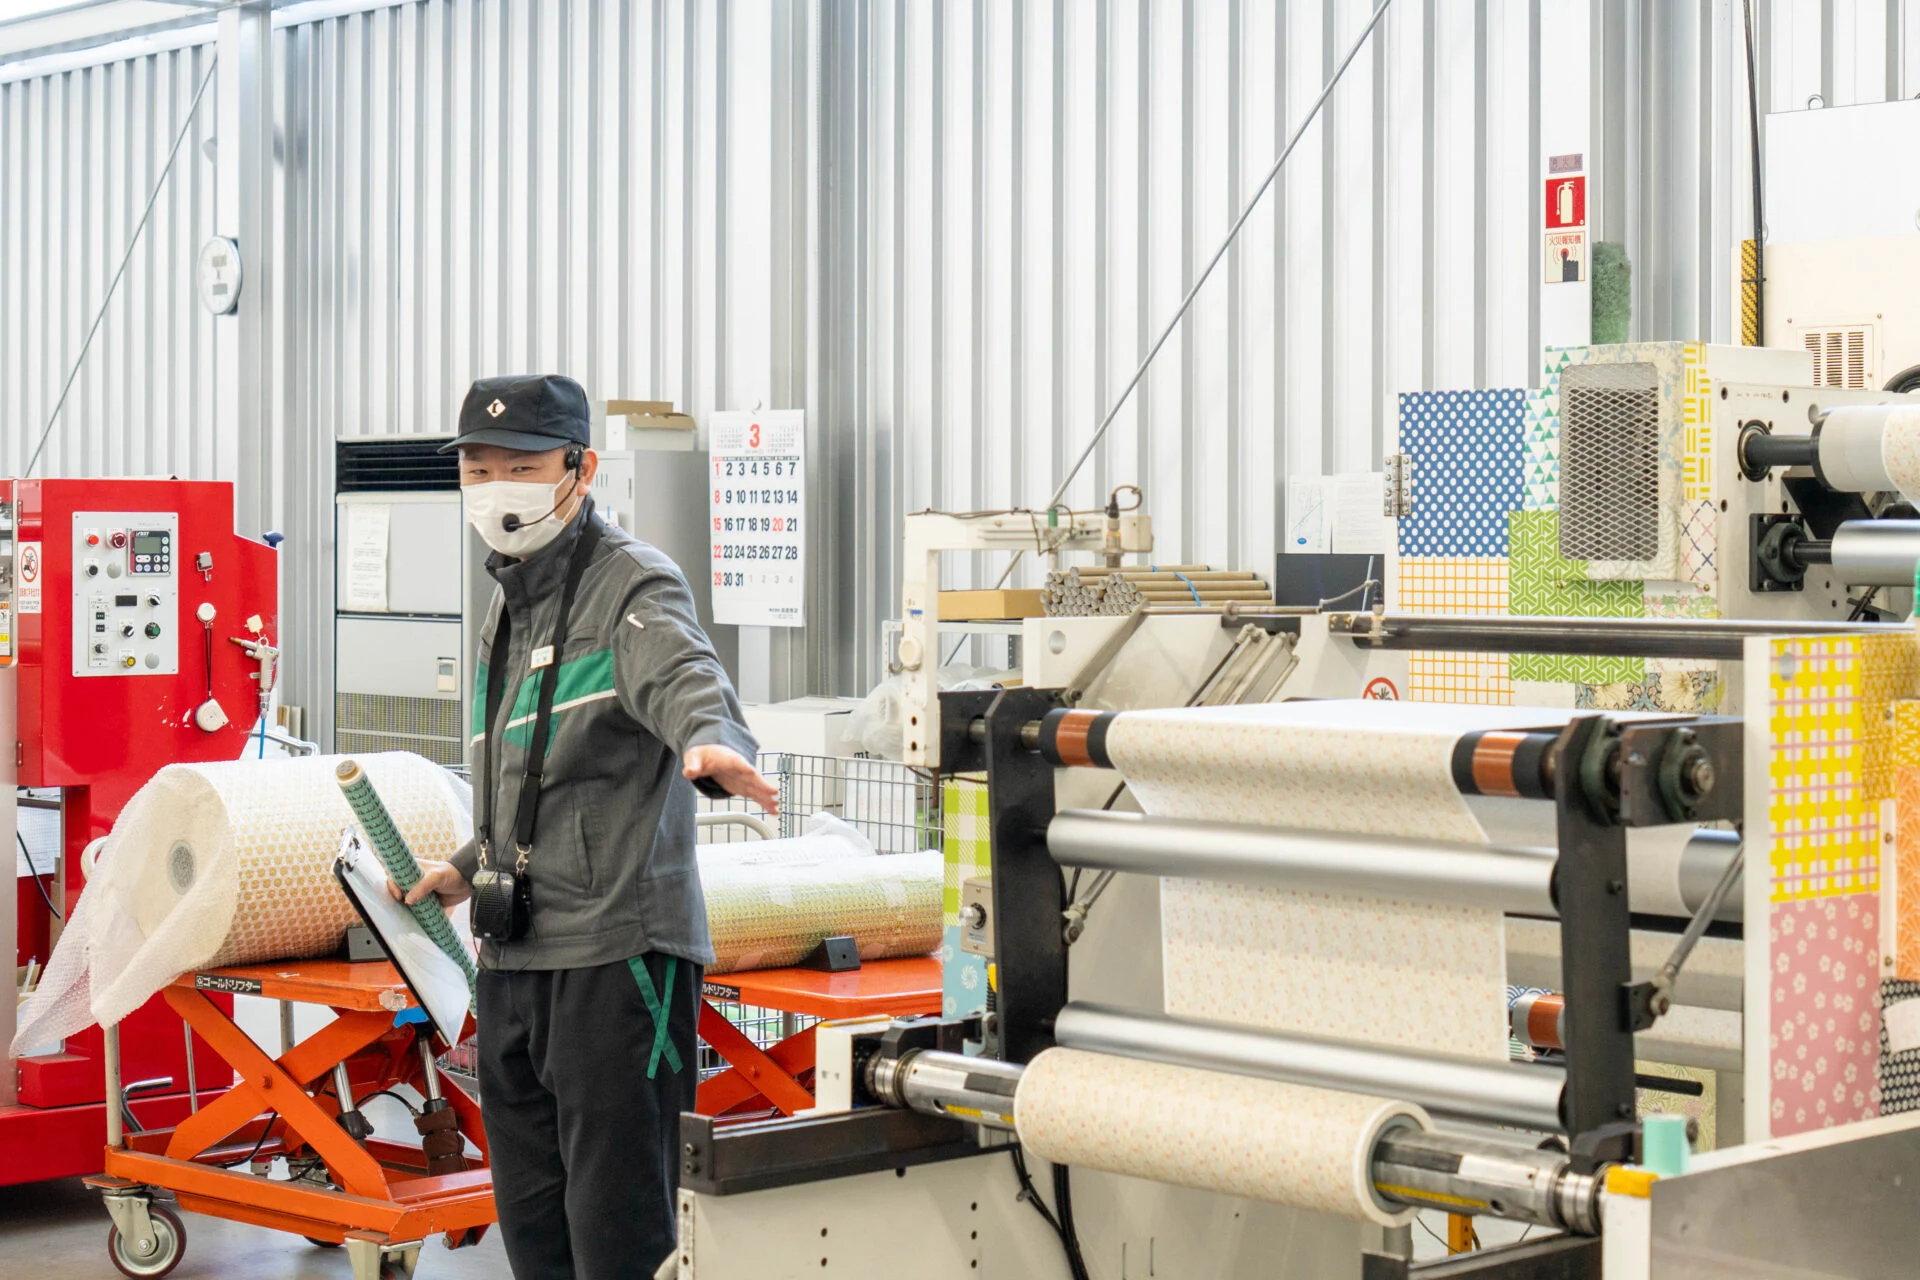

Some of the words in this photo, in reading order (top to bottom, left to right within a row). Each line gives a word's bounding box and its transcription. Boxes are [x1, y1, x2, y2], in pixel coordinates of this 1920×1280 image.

[749, 424, 760, 448] 3
[715, 462, 719, 476] 1
[726, 462, 733, 476] 2
[738, 462, 745, 476] 3
[751, 462, 757, 476] 4
[763, 462, 770, 476] 5
[775, 462, 783, 476] 6
[788, 462, 796, 476] 7
[714, 489, 721, 504] 8
[725, 489, 732, 504] 9
[736, 489, 746, 504] 10
[749, 490, 758, 504] 11
[761, 490, 771, 504] 12
[773, 490, 784, 504] 13
[786, 490, 798, 504] 14
[713, 517, 721, 531] 15
[723, 517, 733, 532] 16
[736, 517, 746, 531] 17
[748, 517, 758, 532] 18
[760, 517, 770, 532] 19
[772, 517, 784, 532] 20
[786, 517, 797, 532] 21
[713, 544, 722, 559] 22
[723, 544, 733, 559] 23
[734, 544, 745, 559] 24
[746, 545, 757, 559] 25
[759, 545, 770, 560] 26
[771, 545, 783, 560] 27
[785, 545, 798, 560] 28
[713, 571, 722, 586] 29
[723, 572, 733, 586] 30
[735, 572, 744, 587] 31
[854, 750, 869, 759] mt
[203, 976, 261, 992] ゴールドリフター
